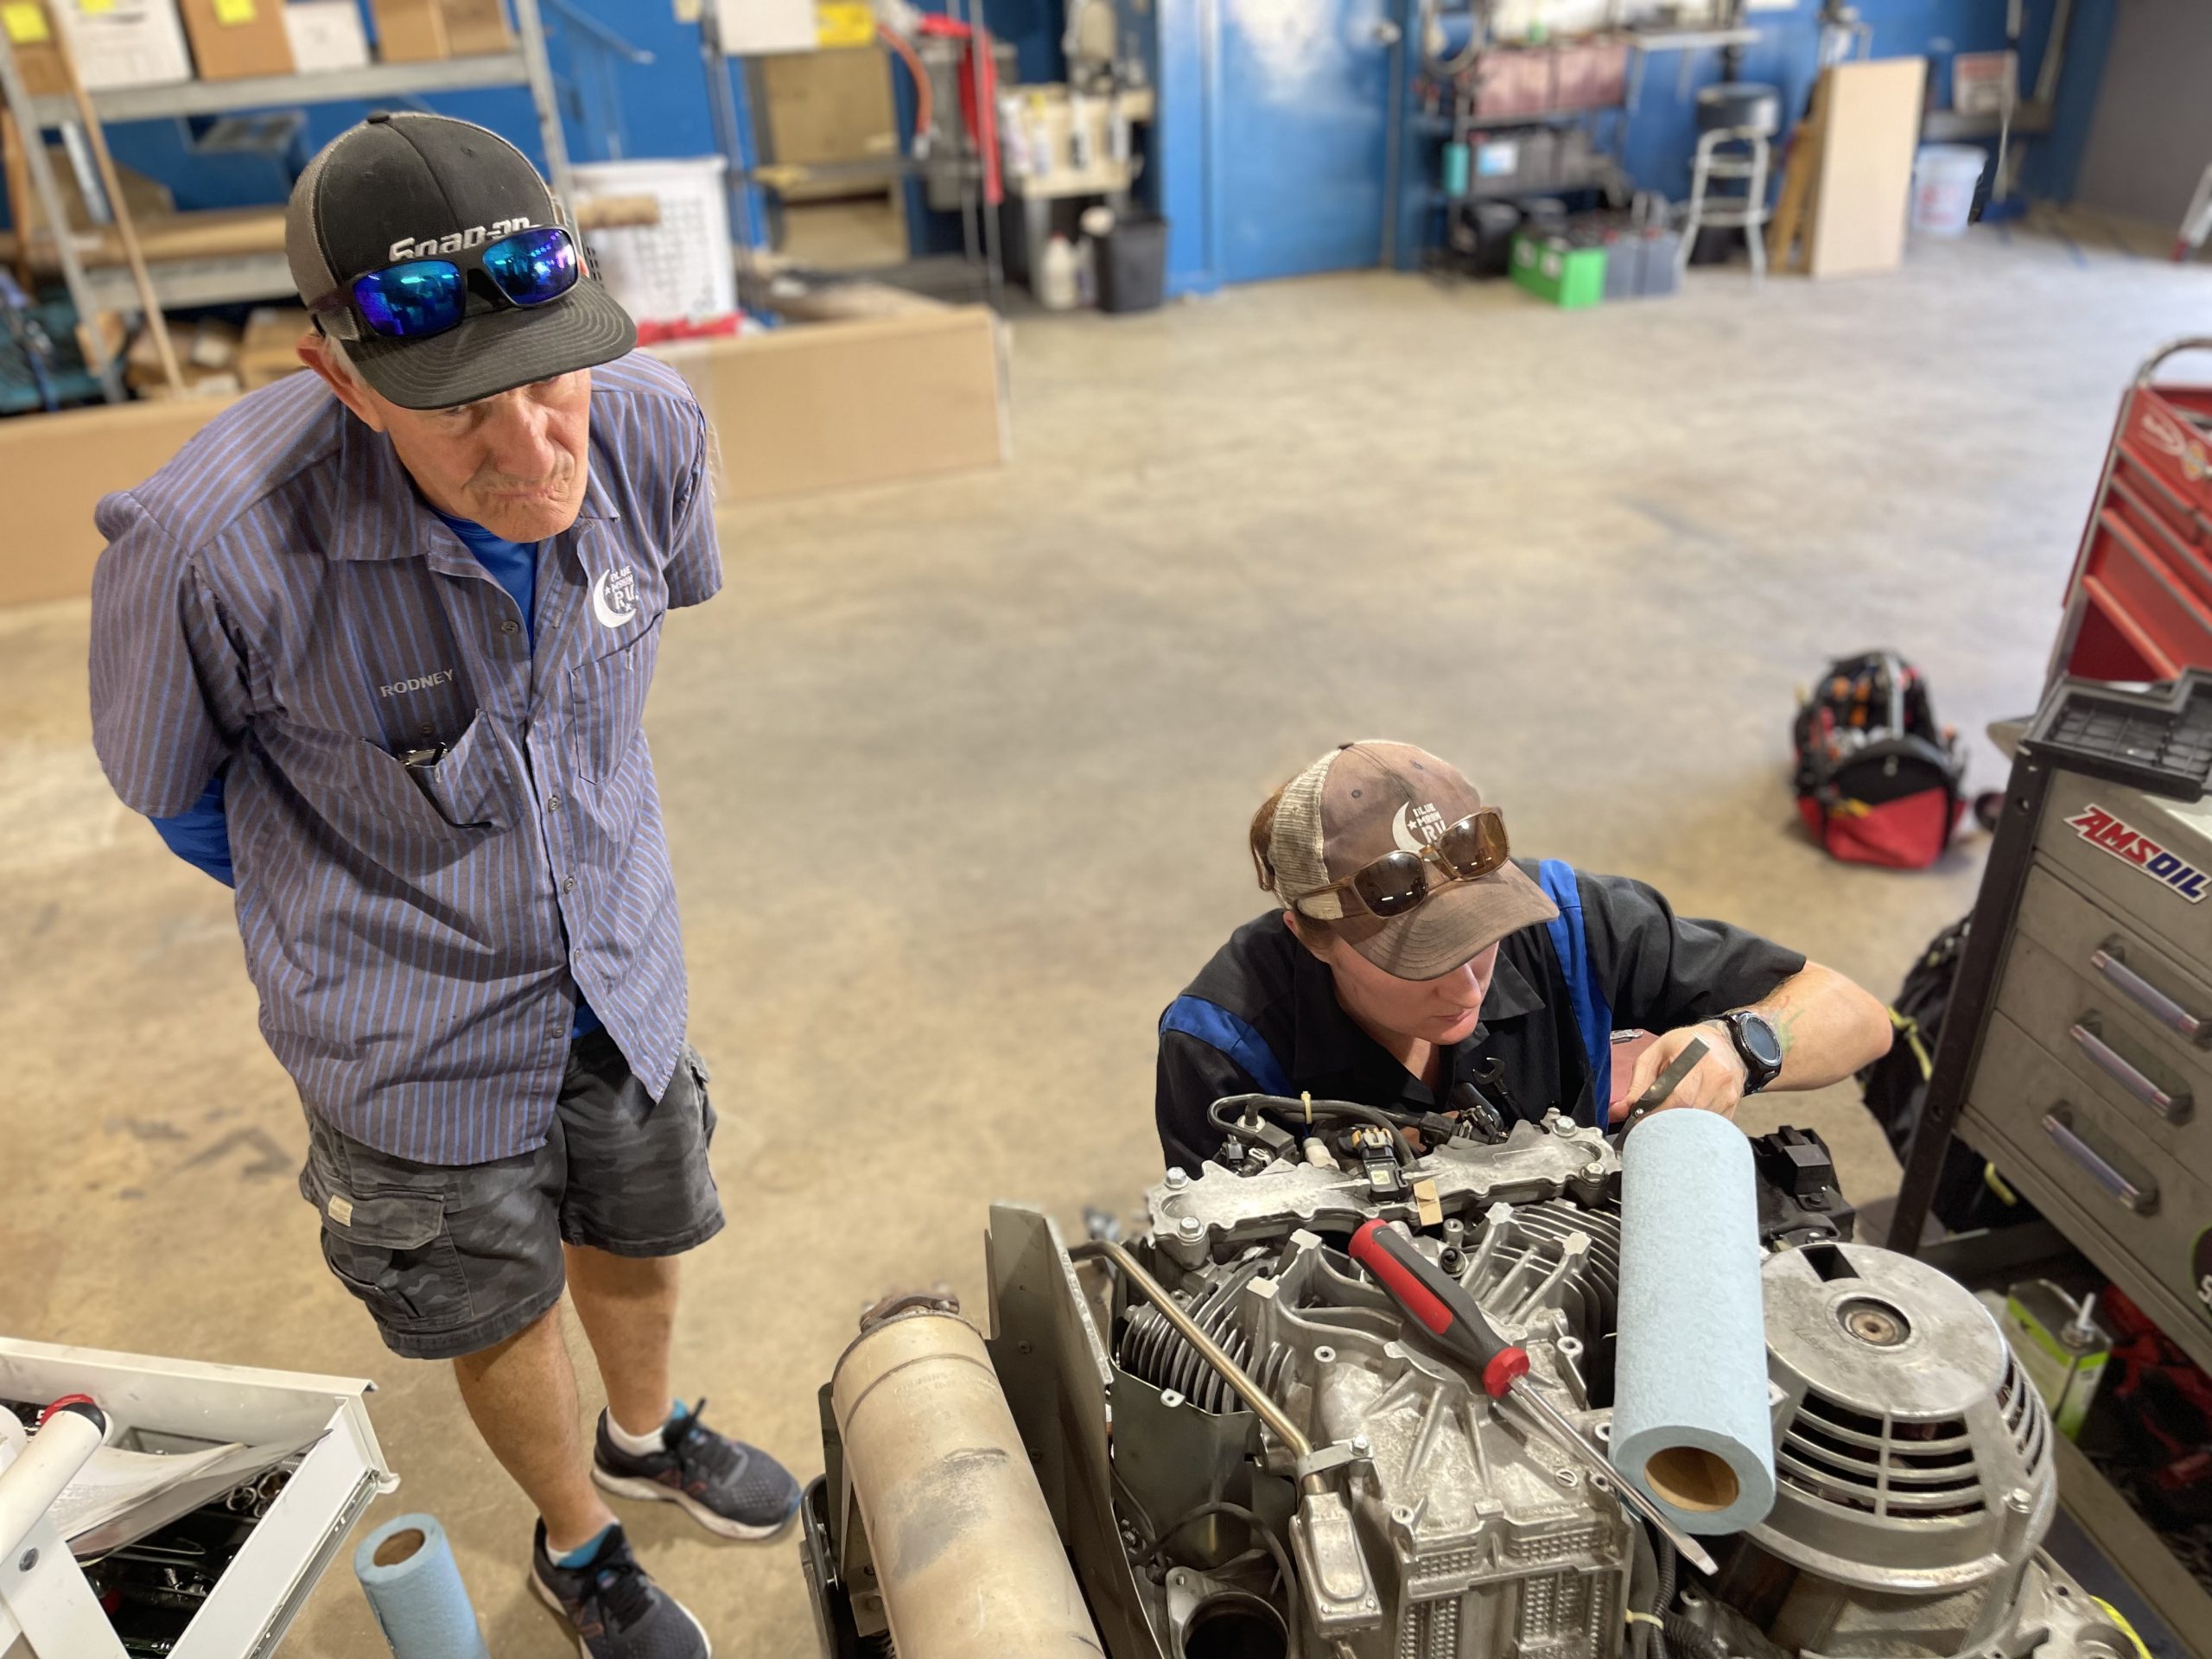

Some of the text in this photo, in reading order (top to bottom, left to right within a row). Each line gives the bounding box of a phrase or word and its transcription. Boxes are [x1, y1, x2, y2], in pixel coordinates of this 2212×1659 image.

[379, 668, 454, 697] RODNEY
[1421, 819, 1447, 844] RV
[2069, 805, 2209, 899] AMSOIL
